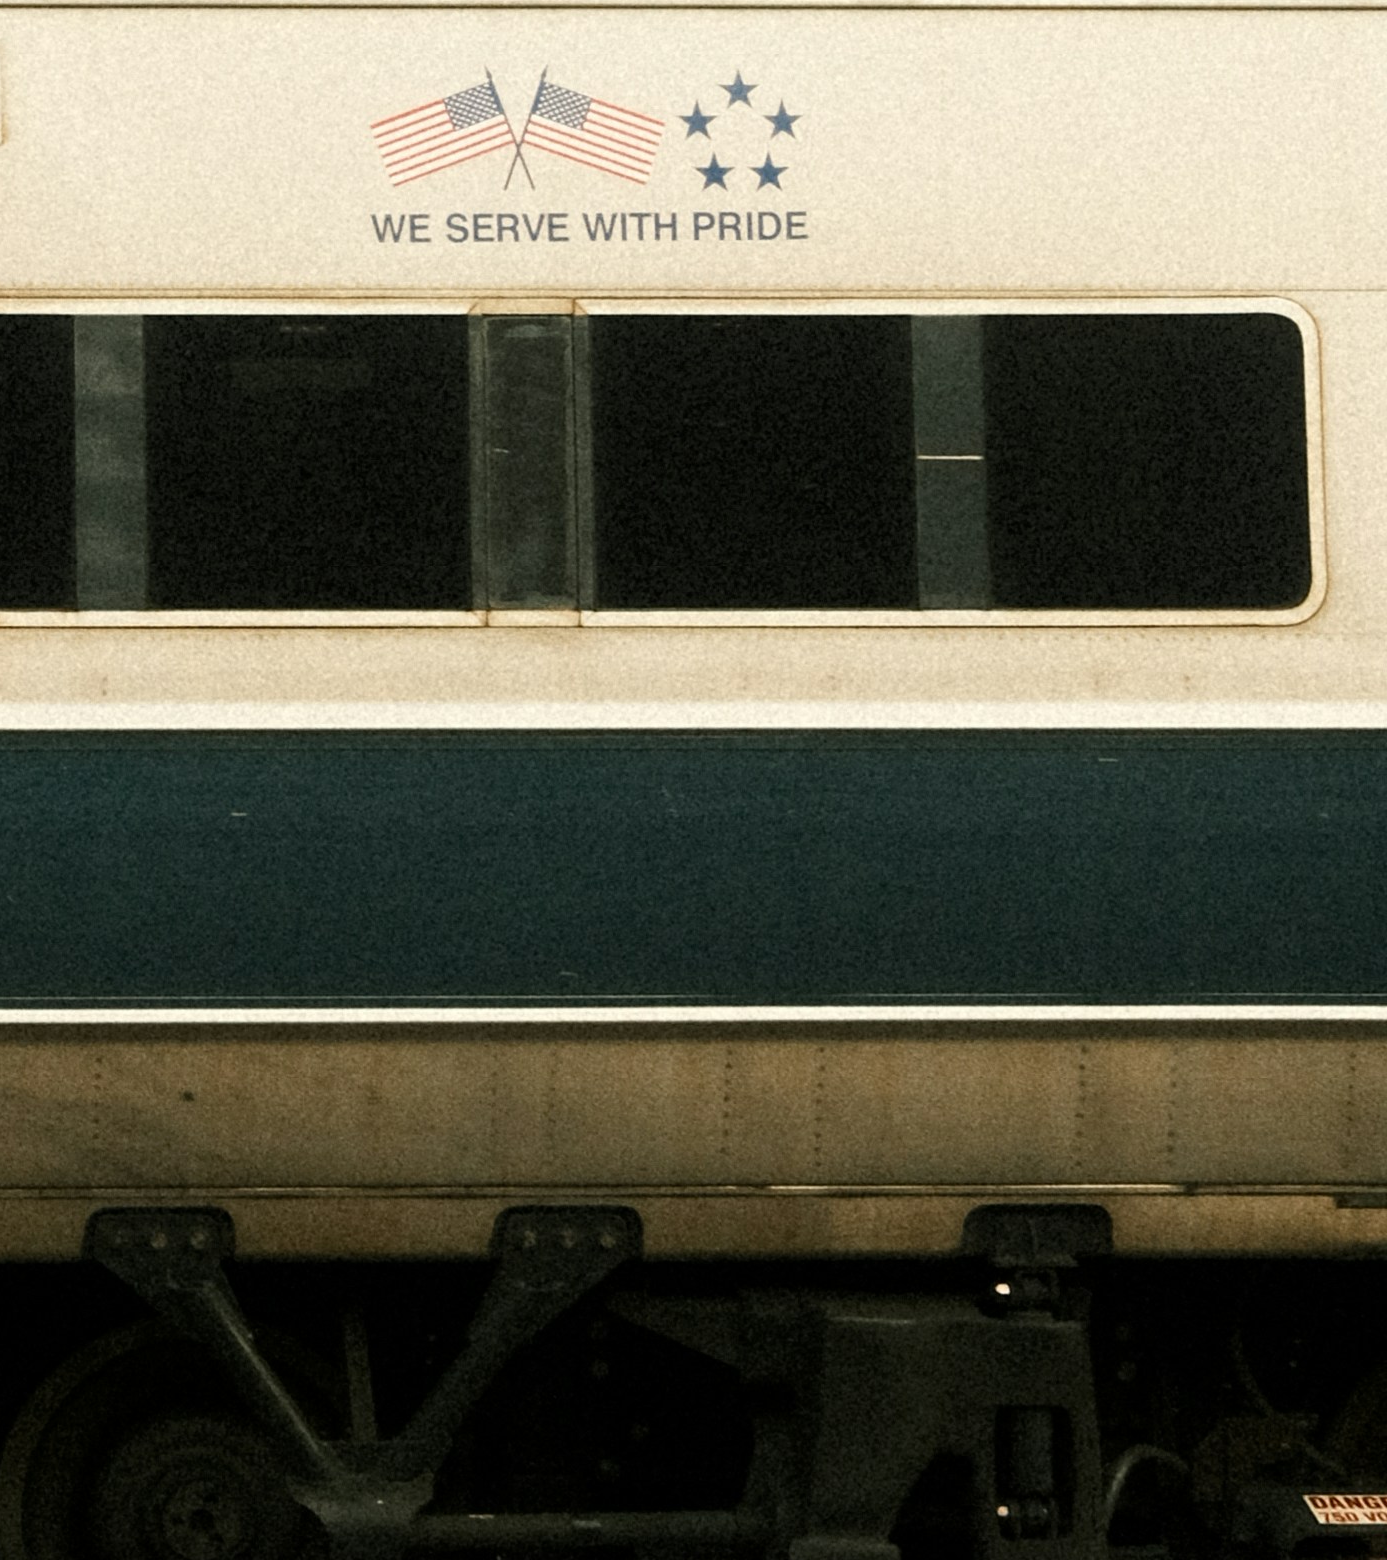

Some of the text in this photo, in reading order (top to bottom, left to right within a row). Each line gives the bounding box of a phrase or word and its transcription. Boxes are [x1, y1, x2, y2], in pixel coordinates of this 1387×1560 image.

[370, 211, 809, 243] WE SERVE WITH PRIDE
[1318, 1512, 1359, 1523] 750
